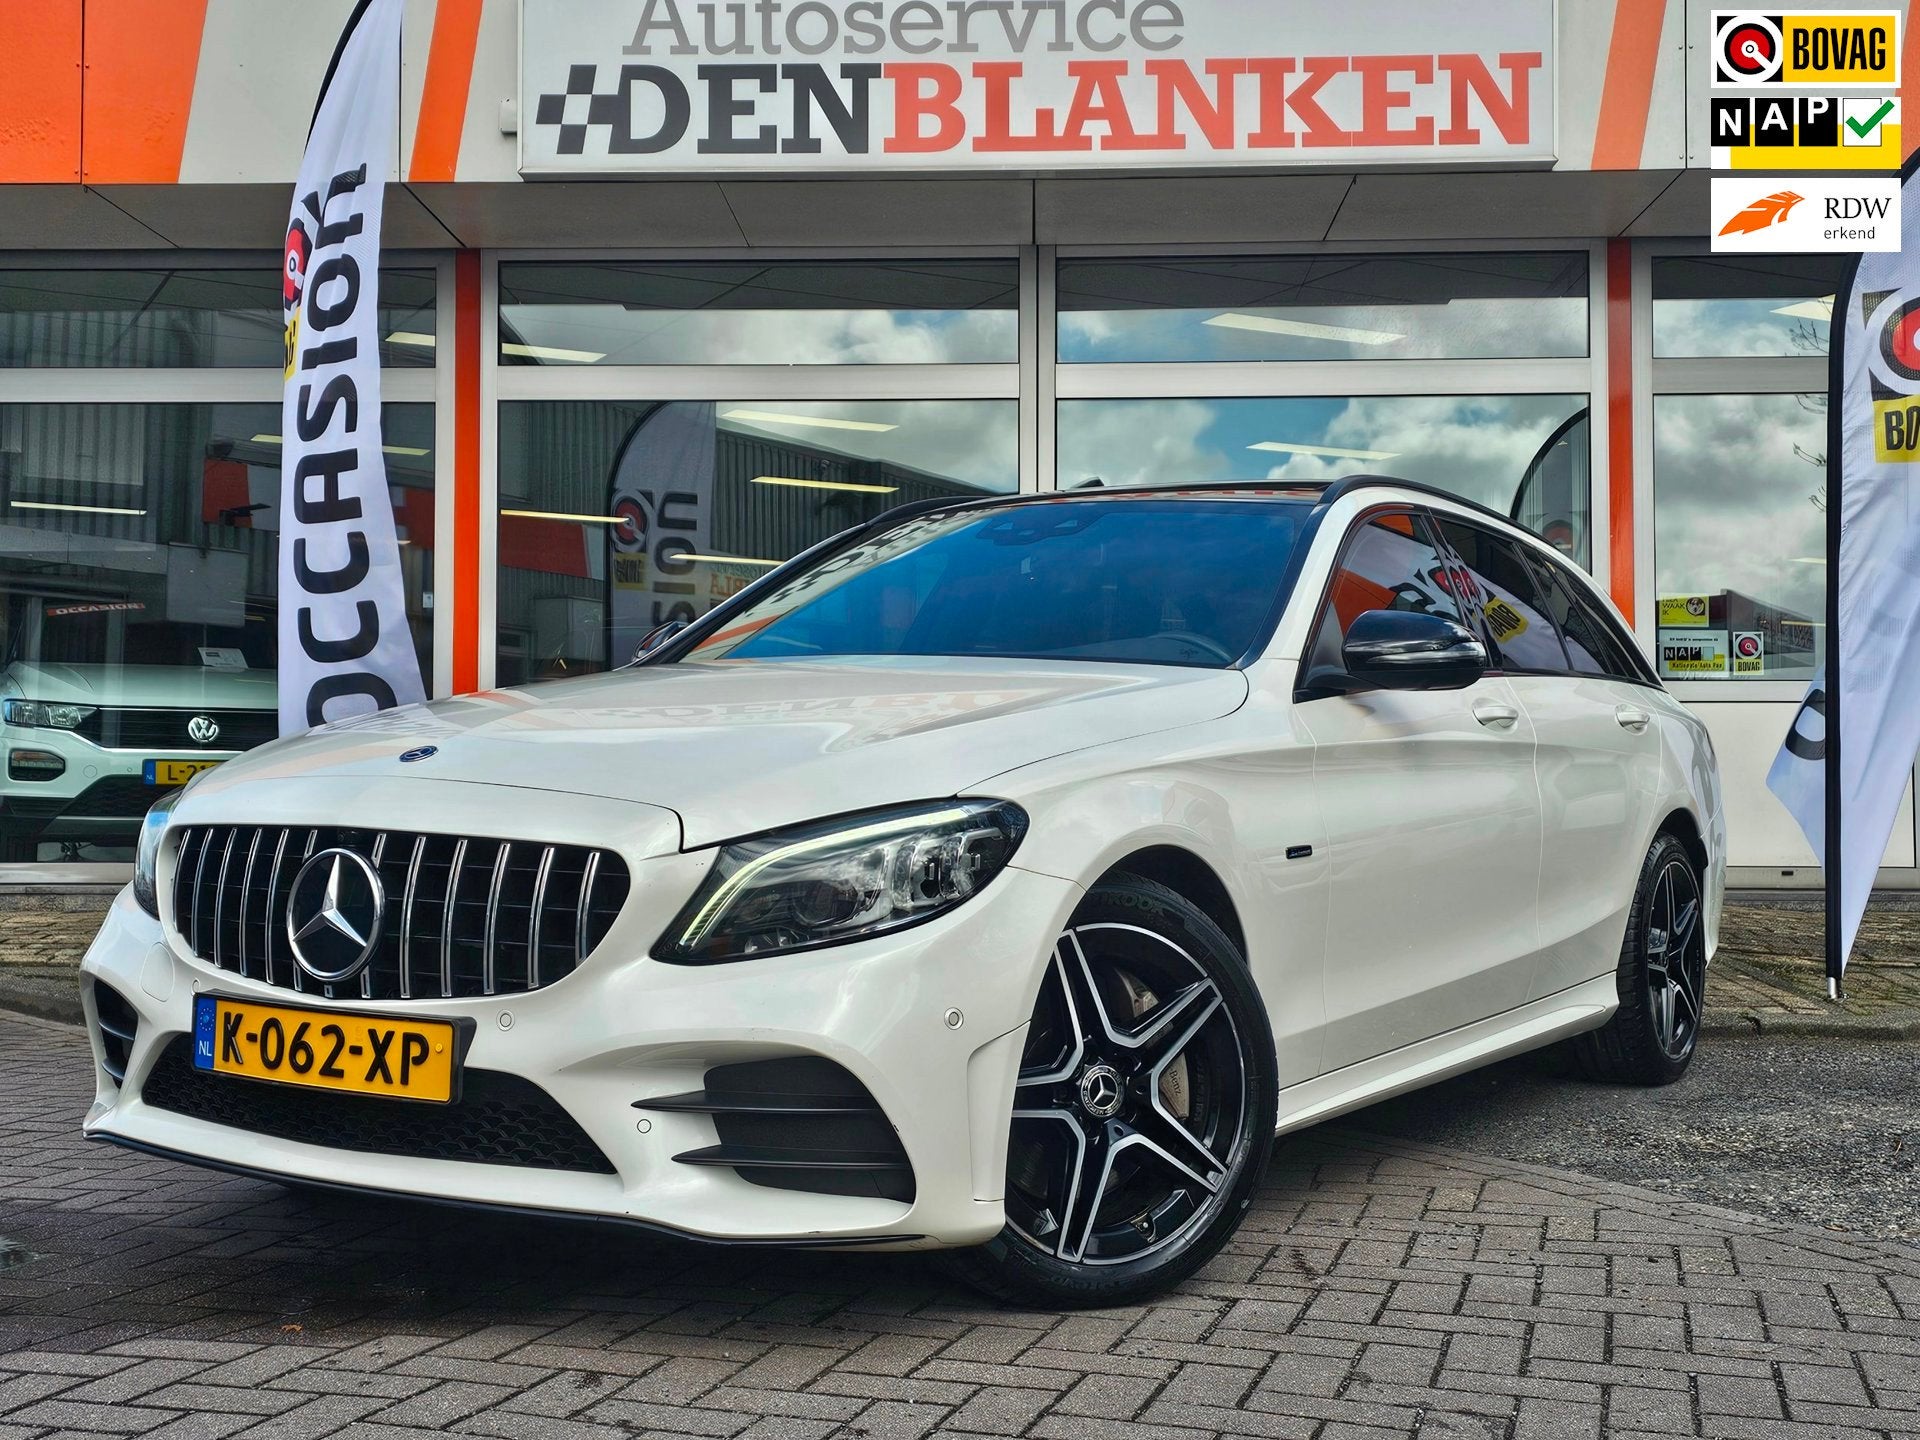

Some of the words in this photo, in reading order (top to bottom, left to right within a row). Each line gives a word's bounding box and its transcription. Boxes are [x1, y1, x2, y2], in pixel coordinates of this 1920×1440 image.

[622, 0, 1185, 55] Autoservice
[56, 602, 139, 615] OCCASION
[1665, 647, 1700, 659] NAP
[1737, 661, 1760, 672] BOVAG
[198, 1040, 213, 1057] NL
[222, 1011, 430, 1086] K-062-XP
